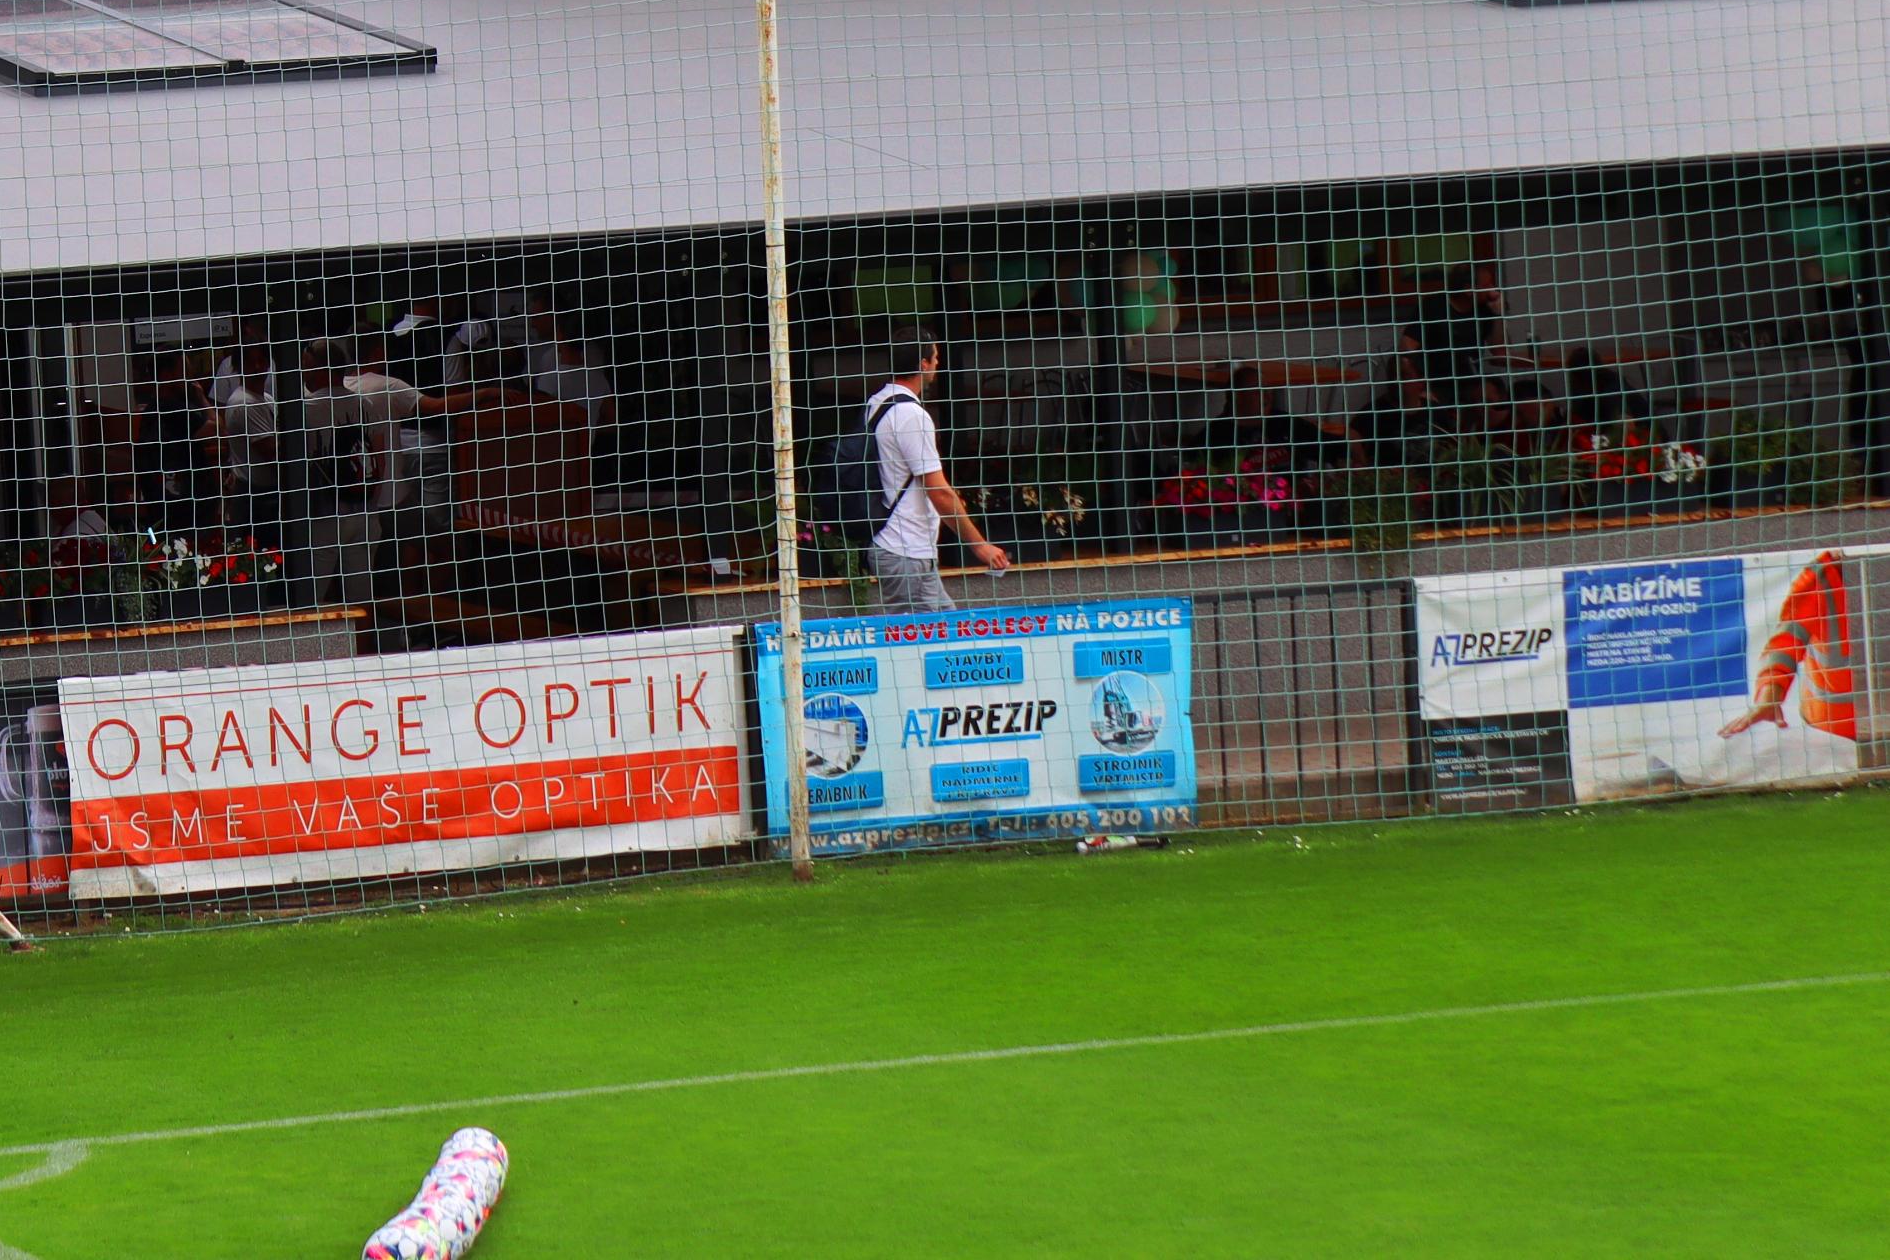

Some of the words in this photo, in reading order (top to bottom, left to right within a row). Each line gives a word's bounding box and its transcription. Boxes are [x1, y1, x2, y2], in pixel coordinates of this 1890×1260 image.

[1580, 575, 1702, 606] NABÍZÍME
[1580, 603, 1649, 622] PRACOVNÍ
[766, 626, 876, 652] HEDÁME
[957, 614, 1048, 637] KOLEGY
[1057, 611, 1090, 631] NA
[1097, 607, 1182, 629] POZICE
[1101, 649, 1142, 666] MISTR
[803, 666, 873, 688] OJEKTANT
[87, 694, 431, 781] ORANGE
[474, 670, 711, 749] OPTIK
[93, 802, 247, 853] JSME
[293, 783, 442, 836] VAŠE
[491, 764, 717, 819] OPTIKA
[1097, 808, 1142, 826] 200
